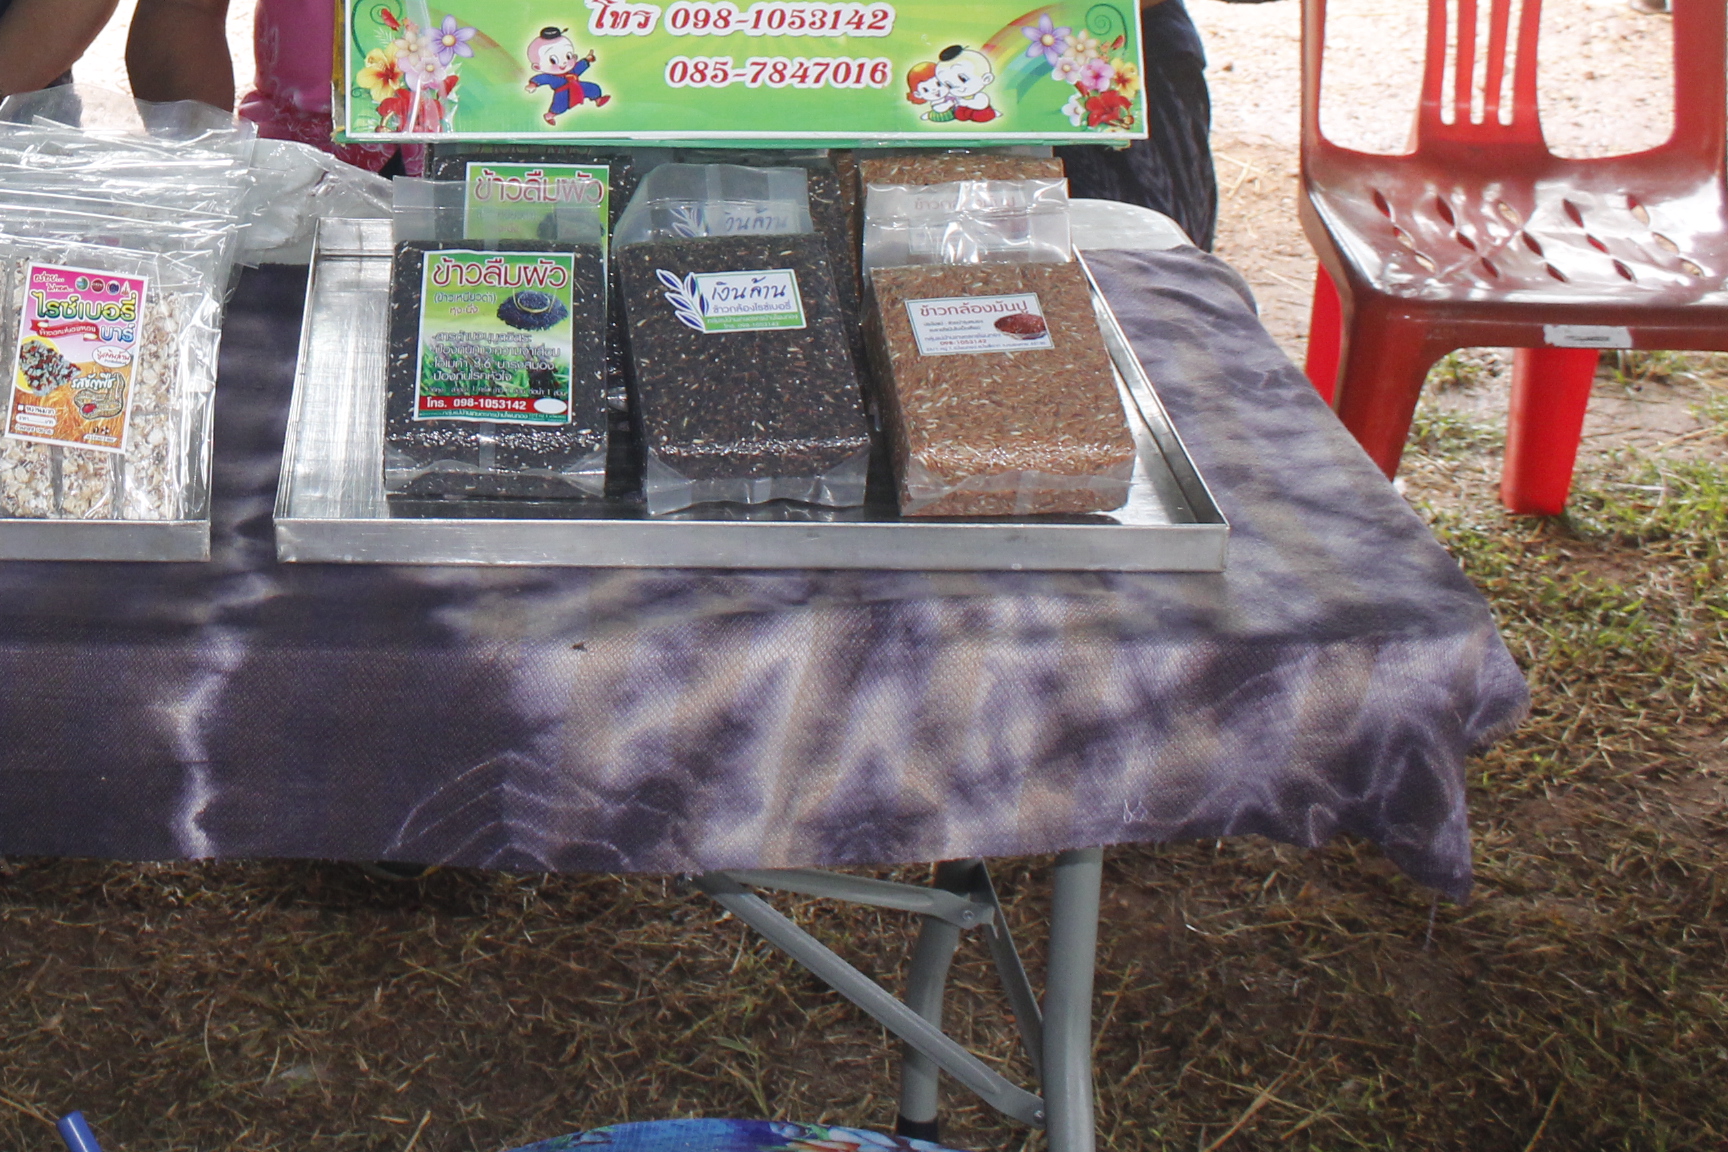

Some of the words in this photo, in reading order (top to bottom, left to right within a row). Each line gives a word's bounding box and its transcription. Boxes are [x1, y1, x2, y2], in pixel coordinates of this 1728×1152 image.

[669, 5, 892, 32] 098-1053142
[667, 57, 890, 86] 085-7847016
[474, 168, 604, 204] ข้าวลืมผัว
[432, 257, 568, 288] ข้าวลืมผัว
[31, 291, 137, 322] ไรซ์เบอรี่
[920, 300, 1029, 317] ข้าวกล้องมันปู
[100, 323, 135, 343] บาร์
[427, 396, 447, 408] โทร.
[453, 398, 527, 410] 098-1053142
